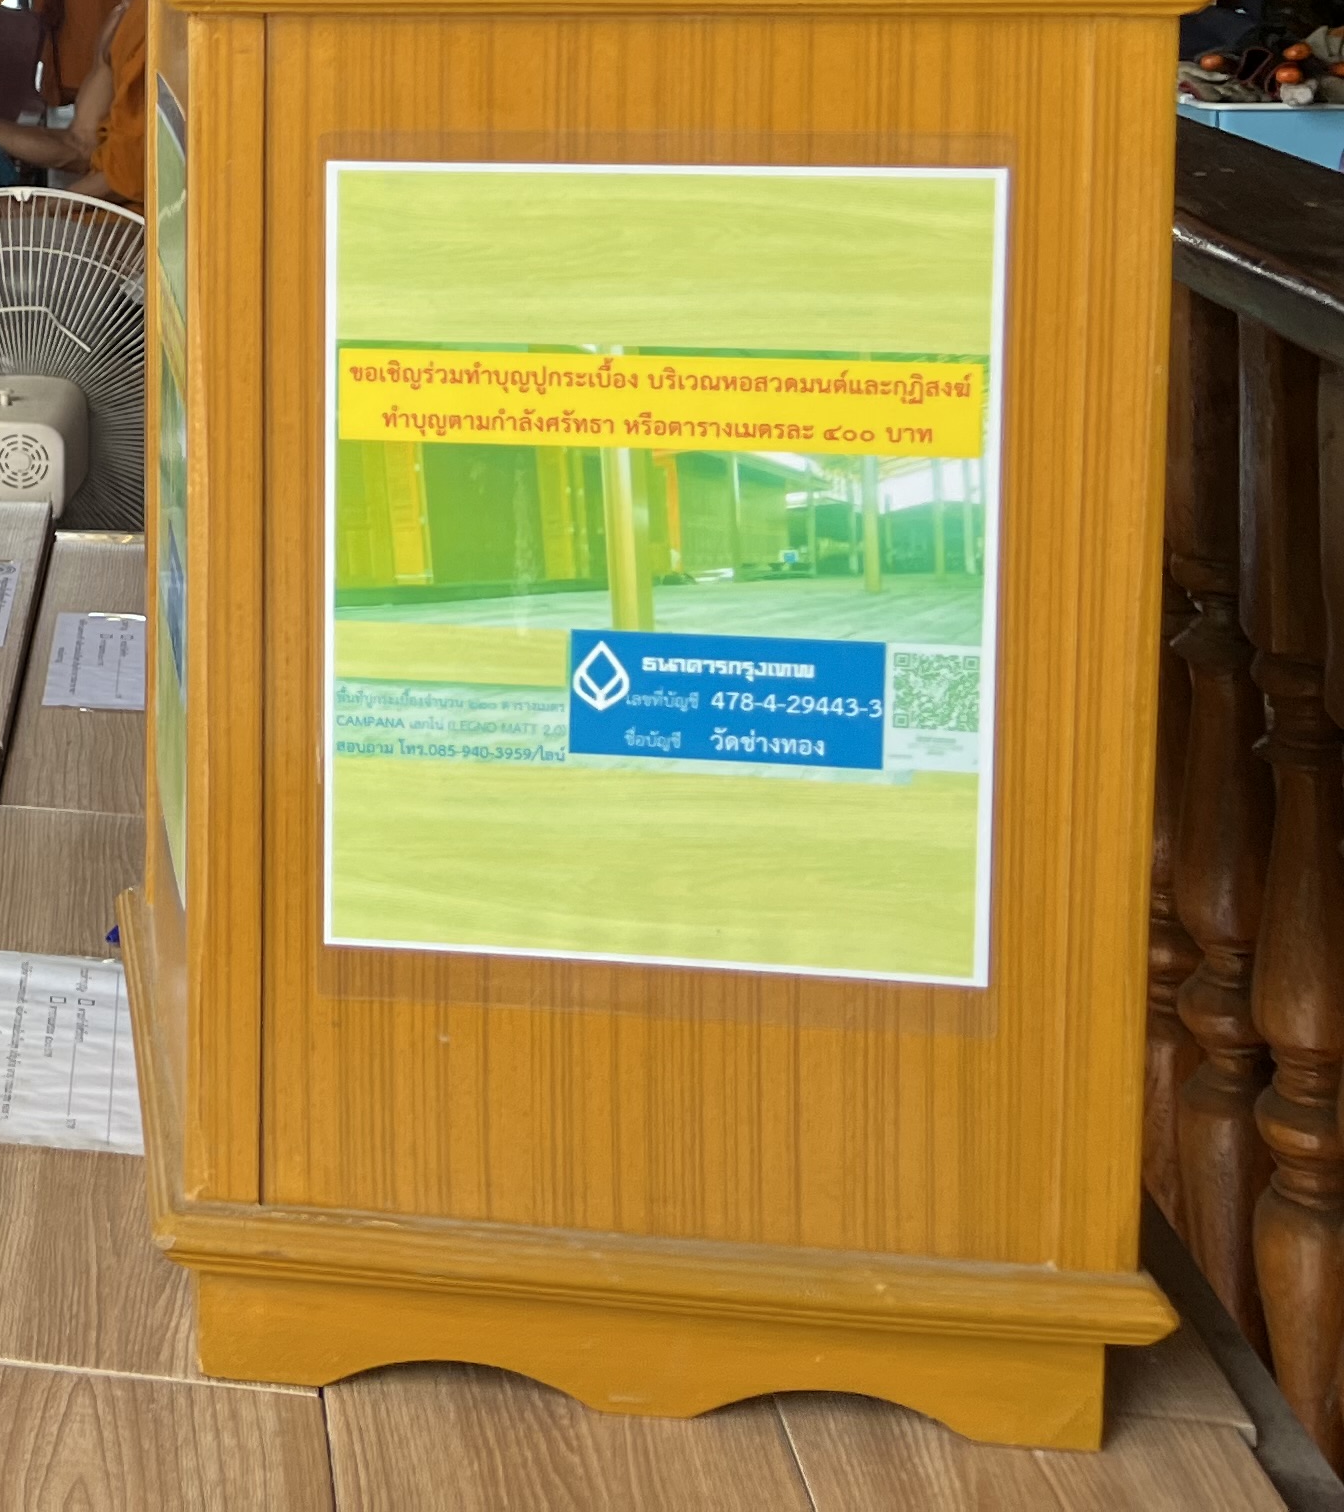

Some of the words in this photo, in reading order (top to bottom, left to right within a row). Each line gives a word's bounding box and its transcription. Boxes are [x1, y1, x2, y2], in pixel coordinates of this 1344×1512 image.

[349, 357, 640, 395] ขอเชิญร่วมทำบุญปูกระเบื้อง
[382, 404, 615, 437] ทำบุญตามกำลังศรัทธา
[624, 411, 815, 442] หรือตารางเมตรละ
[823, 424, 875, 442] ๔๐๐
[886, 425, 934, 444] บาท
[641, 655, 816, 682] ธนาคารกรุงเทพ
[625, 688, 700, 713] เลขที่บัญชี
[710, 691, 884, 719] 478-4-29443-3
[335, 715, 405, 729] CAMPANA
[623, 725, 683, 753] ชื่อบัญชี
[709, 727, 826, 757] วัดช่างทอง
